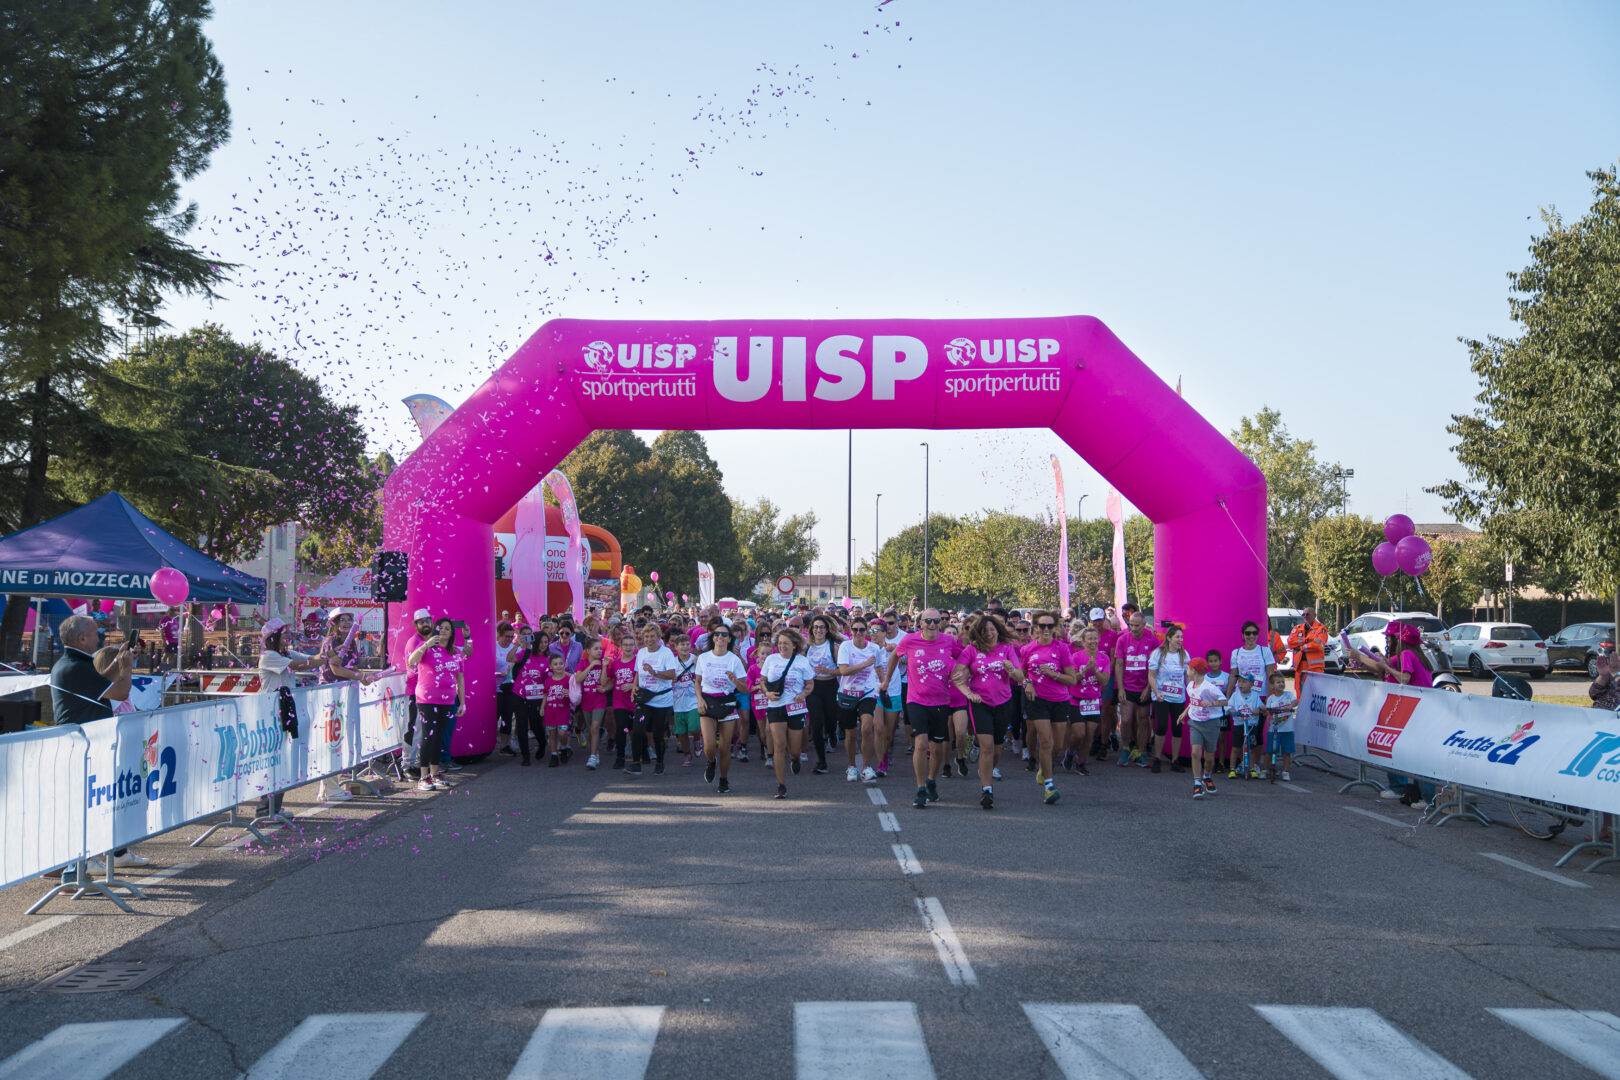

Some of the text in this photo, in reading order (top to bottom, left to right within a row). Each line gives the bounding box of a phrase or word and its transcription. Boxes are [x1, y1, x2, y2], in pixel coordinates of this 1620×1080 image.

[617, 343, 697, 369] UISP
[980, 338, 1060, 364] UISP
[712, 335, 929, 403] UISP
[581, 376, 697, 401] sportpertutti
[944, 371, 1061, 398] sportpertutti
[546, 548, 566, 557] ona
[546, 560, 566, 572] gue
[0, 570, 152, 589] NE DI MOZZECAN
[1368, 730, 1398, 747] STULZ
[1442, 729, 1496, 752] Frutta
[88, 769, 142, 809] Frutta
